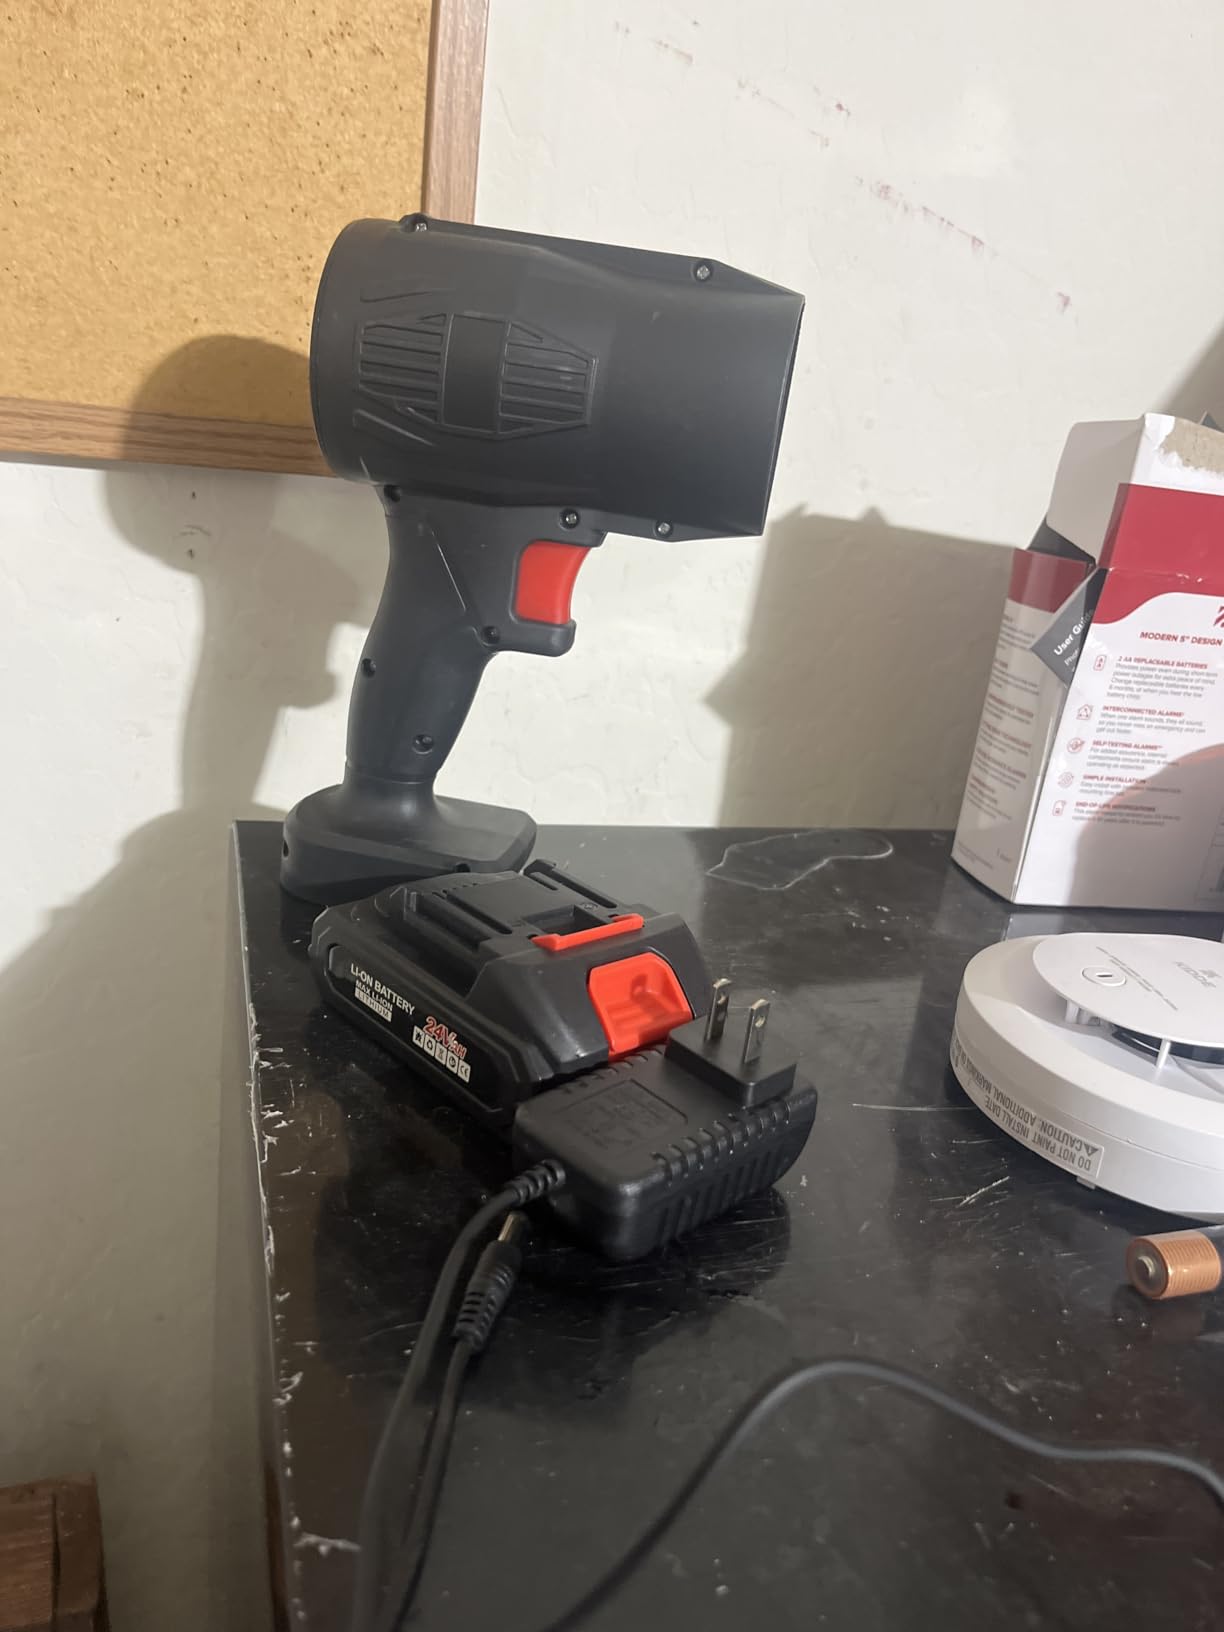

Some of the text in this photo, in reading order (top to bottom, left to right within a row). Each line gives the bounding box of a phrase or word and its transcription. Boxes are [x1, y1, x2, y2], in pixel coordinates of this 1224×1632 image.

[1054, 634, 1073, 655] User
[1140, 632, 1178, 642] MODERN
[1191, 637, 1223, 646] DESIGN
[1133, 657, 1175, 666] REPLACEABLE
[1176, 661, 1208, 669] BATTERIES
[351, 963, 415, 1015] LI-ON BATTERY
[356, 980, 393, 1011] MAX LI-ION
[994, 1087, 1036, 1126] ADDITIONAL
[1002, 1112, 1030, 1139] INSTALL
[1033, 1132, 1056, 1153] PAINT
[1057, 1147, 1076, 1164] NOT
[1079, 1156, 1092, 1171] DO
